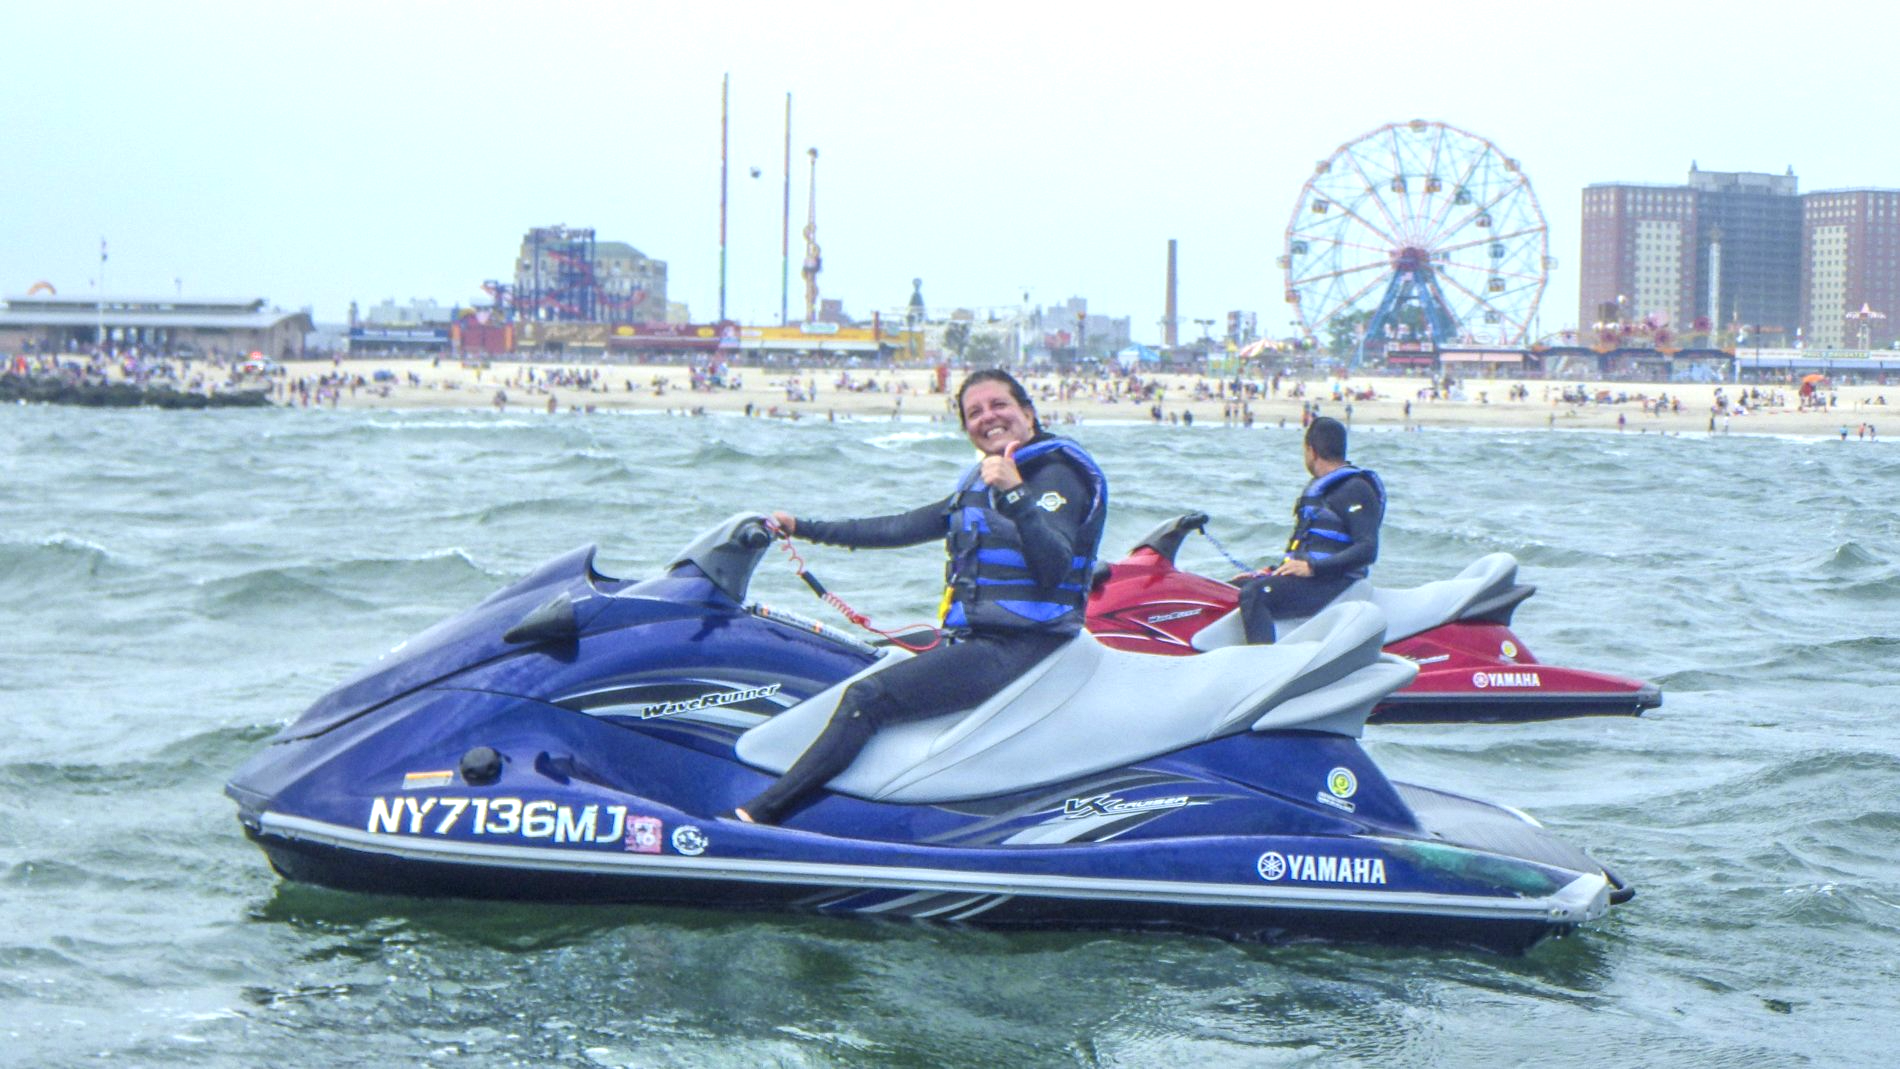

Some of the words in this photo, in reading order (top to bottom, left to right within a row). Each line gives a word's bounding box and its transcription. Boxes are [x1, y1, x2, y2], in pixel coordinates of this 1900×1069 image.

[1487, 672, 1541, 687] YAMAHA
[641, 683, 782, 719] WaveRunner
[367, 797, 628, 845] NY7136MJ
[1286, 854, 1387, 885] YAMAHA
